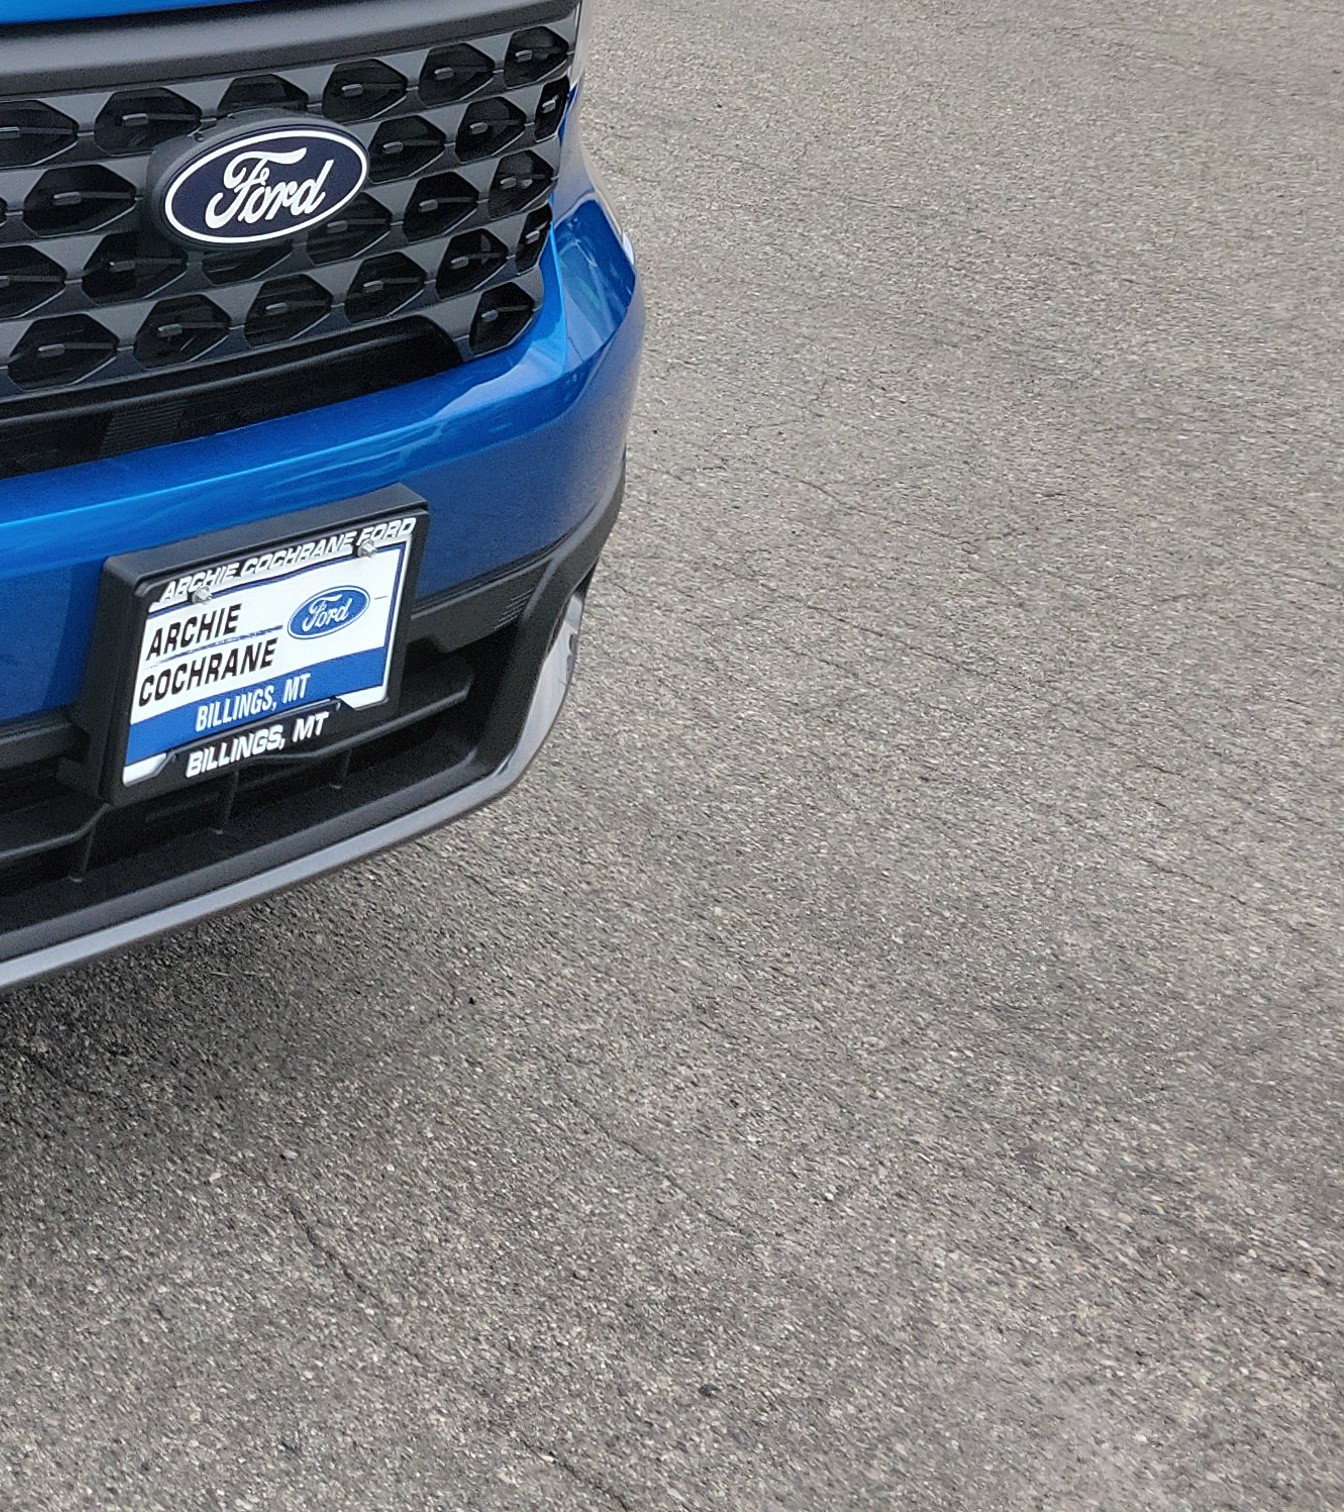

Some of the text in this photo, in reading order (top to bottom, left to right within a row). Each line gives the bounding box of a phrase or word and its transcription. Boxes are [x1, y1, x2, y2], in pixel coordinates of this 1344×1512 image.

[204, 146, 335, 229] Ford
[158, 517, 417, 603] ARCHIE COCHRANE FORD
[146, 603, 242, 661] ARCHIE
[302, 593, 353, 632] Ford
[138, 637, 278, 708] COCHRANE
[194, 673, 311, 732] BILLINGS, MT
[185, 711, 330, 778] BILLINGS, MT
